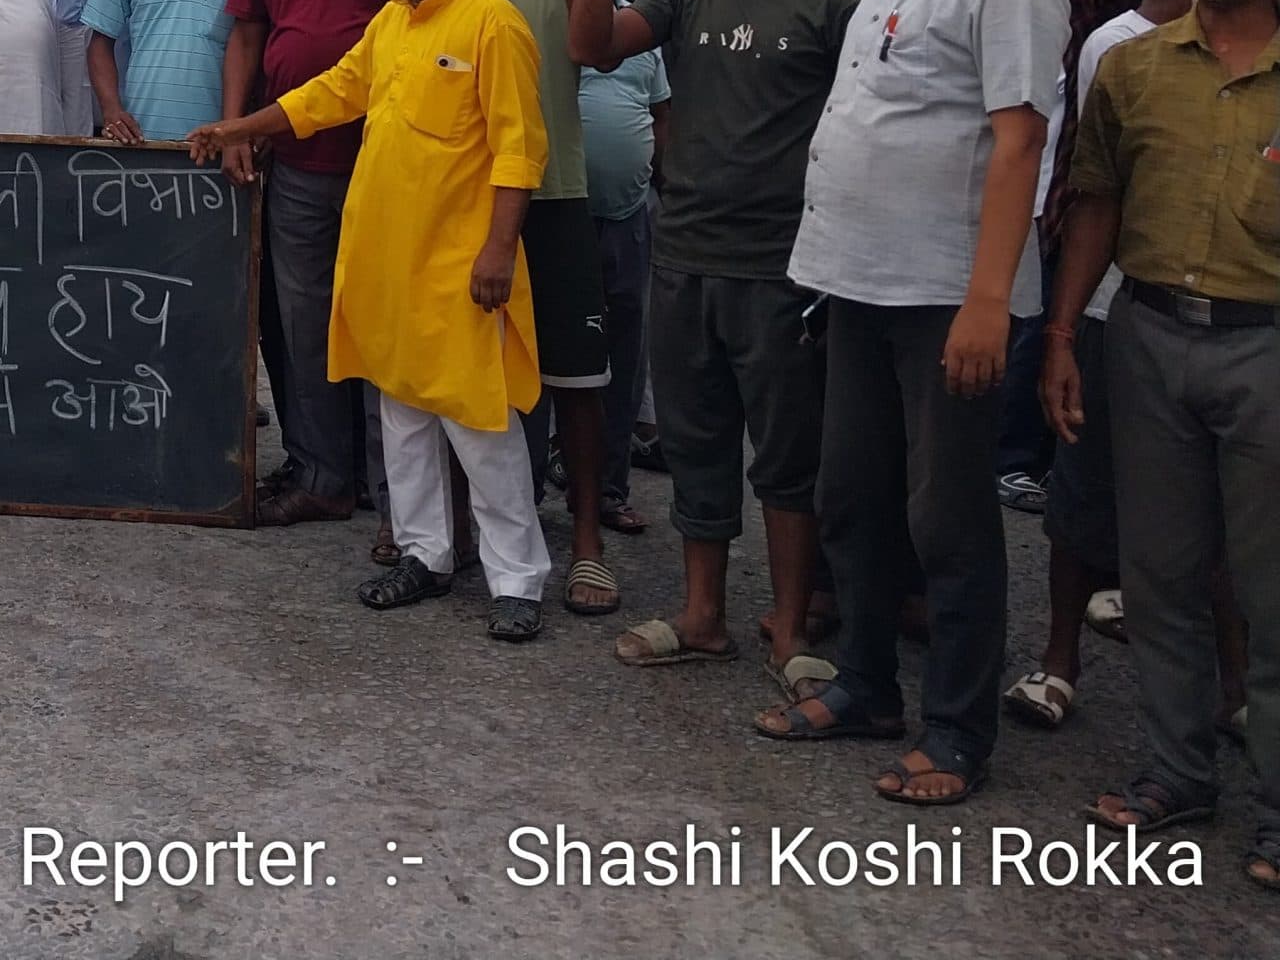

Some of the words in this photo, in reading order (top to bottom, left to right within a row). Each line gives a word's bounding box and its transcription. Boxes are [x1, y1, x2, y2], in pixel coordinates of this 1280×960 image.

[68, 150, 239, 242] विभाग
[48, 265, 193, 364] हाय
[46, 363, 173, 432] आओ
